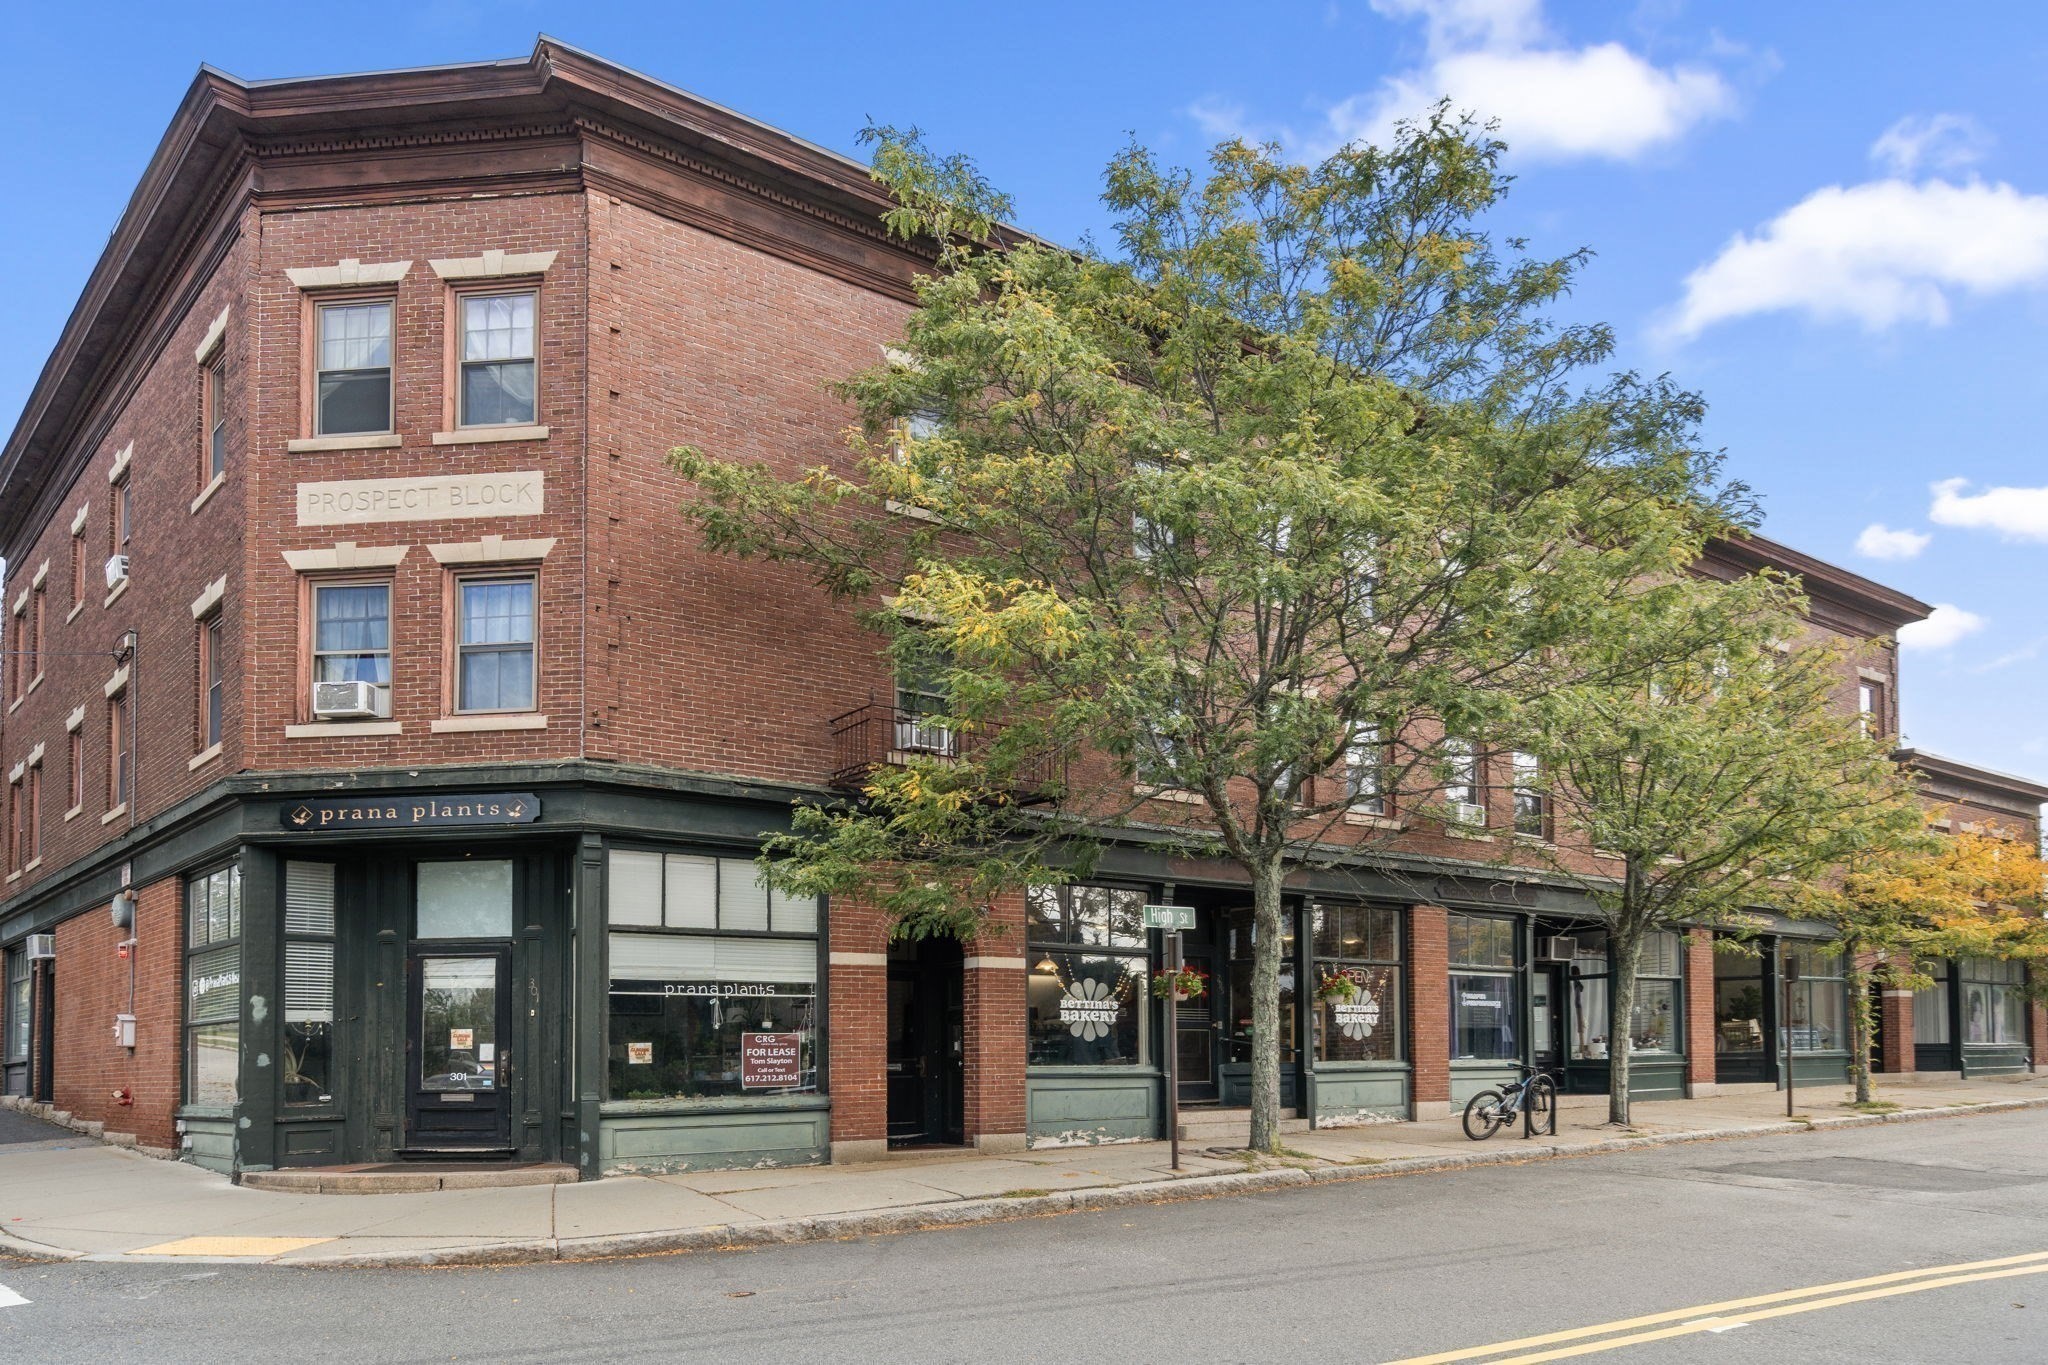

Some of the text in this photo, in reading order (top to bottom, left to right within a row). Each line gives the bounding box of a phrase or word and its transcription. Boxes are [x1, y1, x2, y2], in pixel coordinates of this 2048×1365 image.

[308, 482, 535, 513] PROSPECT BLOCK
[320, 801, 500, 825] prana plants
[1151, 907, 1188, 926] High St
[1343, 970, 1370, 984] PEN
[664, 983, 775, 999] prana plants
[755, 1035, 775, 1043] CRG
[746, 1048, 796, 1056] FOR LEASE
[766, 1058, 793, 1066] Slayton
[450, 1073, 467, 1081] 301
[745, 1074, 798, 1082] 617.212.8104
